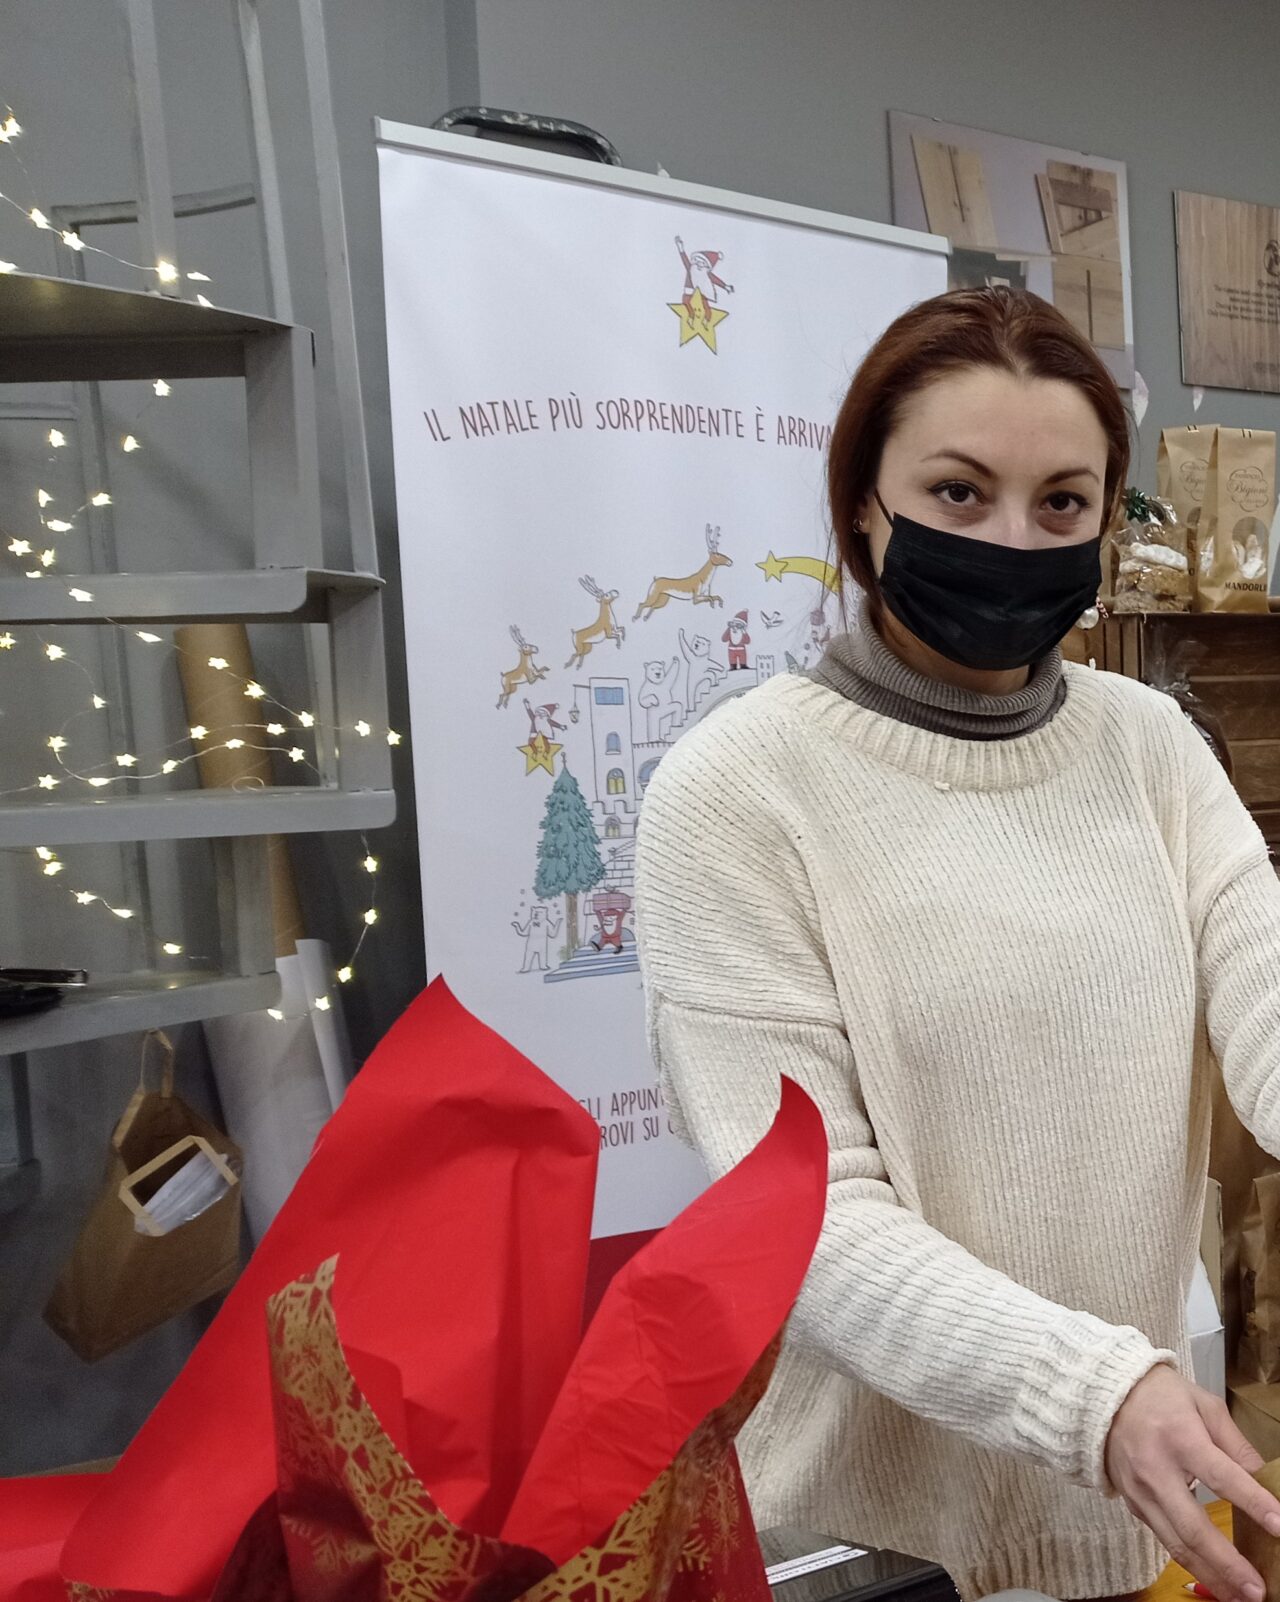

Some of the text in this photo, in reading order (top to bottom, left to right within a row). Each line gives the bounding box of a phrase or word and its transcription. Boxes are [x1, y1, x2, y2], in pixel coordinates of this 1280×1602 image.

[423, 408, 452, 443] IL
[459, 398, 540, 440] NATALE
[548, 391, 583, 431] PIÙ
[596, 397, 745, 438] SORPRENDENTE
[755, 405, 766, 443] È
[643, 1116, 659, 1141] SU
